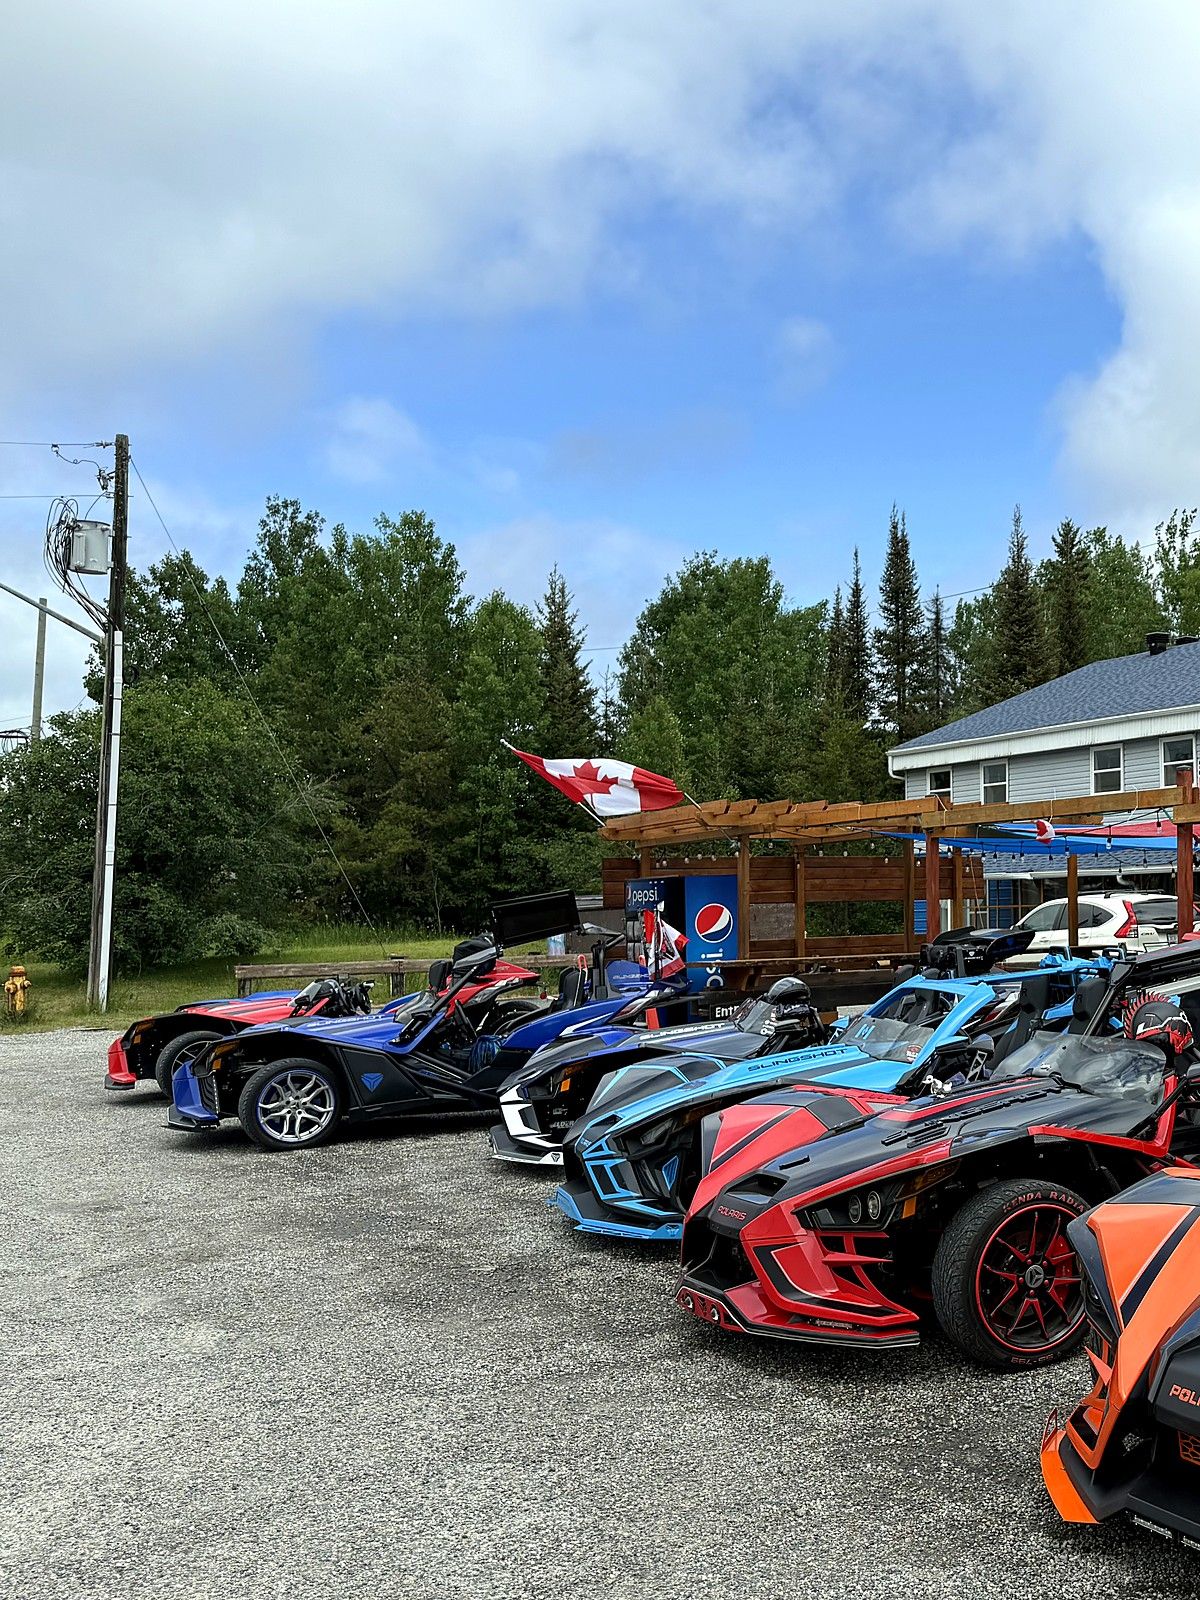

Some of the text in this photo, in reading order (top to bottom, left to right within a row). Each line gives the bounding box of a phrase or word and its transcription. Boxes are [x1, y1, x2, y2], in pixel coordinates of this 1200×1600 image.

[632, 887, 658, 905] pepsi
[639, 1022, 726, 1041] SLINGSHOT
[747, 1048, 848, 1072] SLINGSHOT
[1002, 1191, 1042, 1213] KENDA
[716, 1205, 747, 1222] POLARIS
